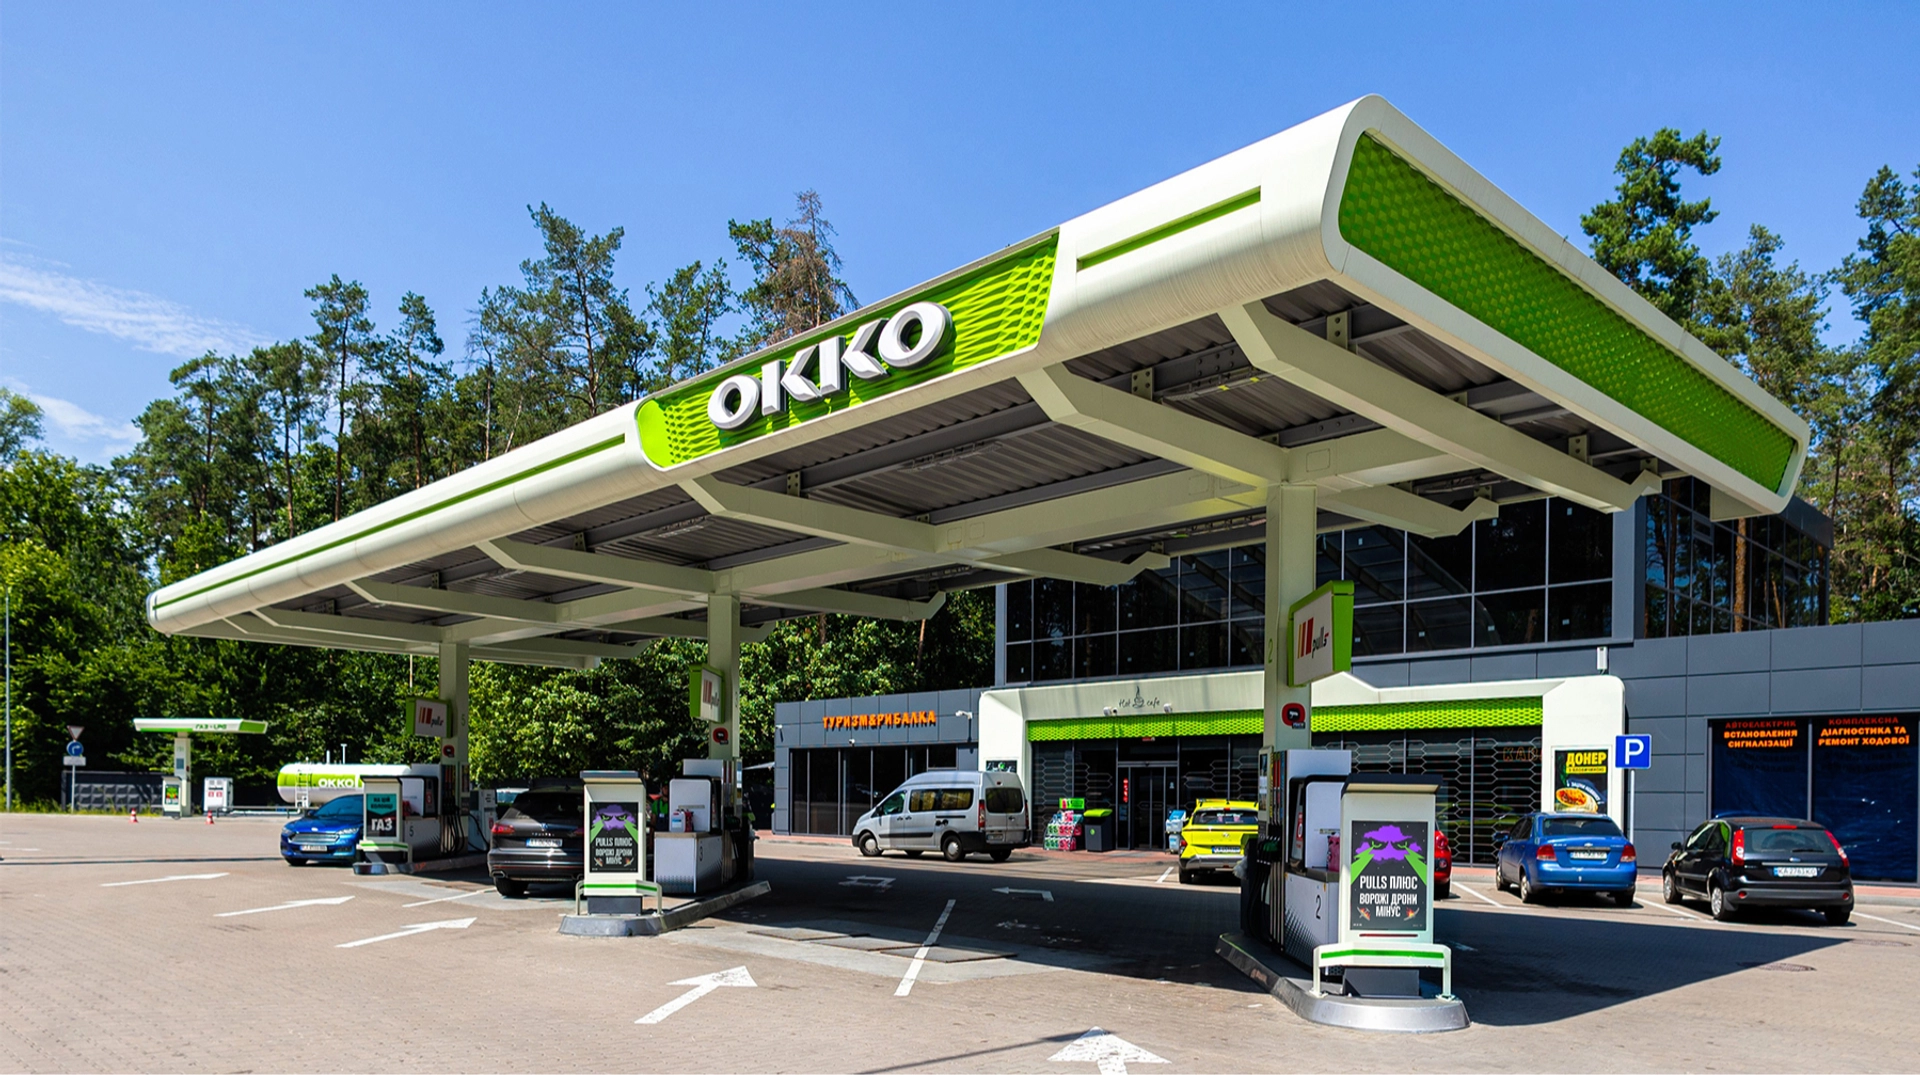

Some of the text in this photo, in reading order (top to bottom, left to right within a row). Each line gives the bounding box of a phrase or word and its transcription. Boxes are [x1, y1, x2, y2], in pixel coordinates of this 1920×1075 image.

[707, 301, 953, 431] OKKO
[1311, 626, 1329, 659] pulls
[822, 710, 937, 729] ТУРИЗМ&РИБАЛКА
[1725, 720, 1797, 728] АВТОЕЛЕКТРИК
[1828, 717, 1899, 725] КОМПЛЕКСНА
[1724, 730, 1798, 739] ВСТАНОВЛЕННЯ
[1820, 726, 1907, 737] ДІАГНОСТИКА ТА
[1728, 738, 1793, 748] СИГНАЛІЗАЦІЇ
[1818, 735, 1910, 746] РЕМОНТ ХОДОВОЇ
[1503, 746, 1542, 761] КАВ
[1625, 739, 1644, 765] P
[1566, 752, 1607, 767] ДОНЕР
[318, 778, 355, 788] OKKO
[371, 818, 393, 831] ГАЗ
[596, 837, 613, 846] PULLS
[1360, 875, 1418, 889] PULLS ПЛЮС
[1360, 893, 1418, 906] ВОРОЖІ ДРОНИ
[1315, 894, 1322, 920] 2
[1376, 905, 1401, 917] МІНУС
